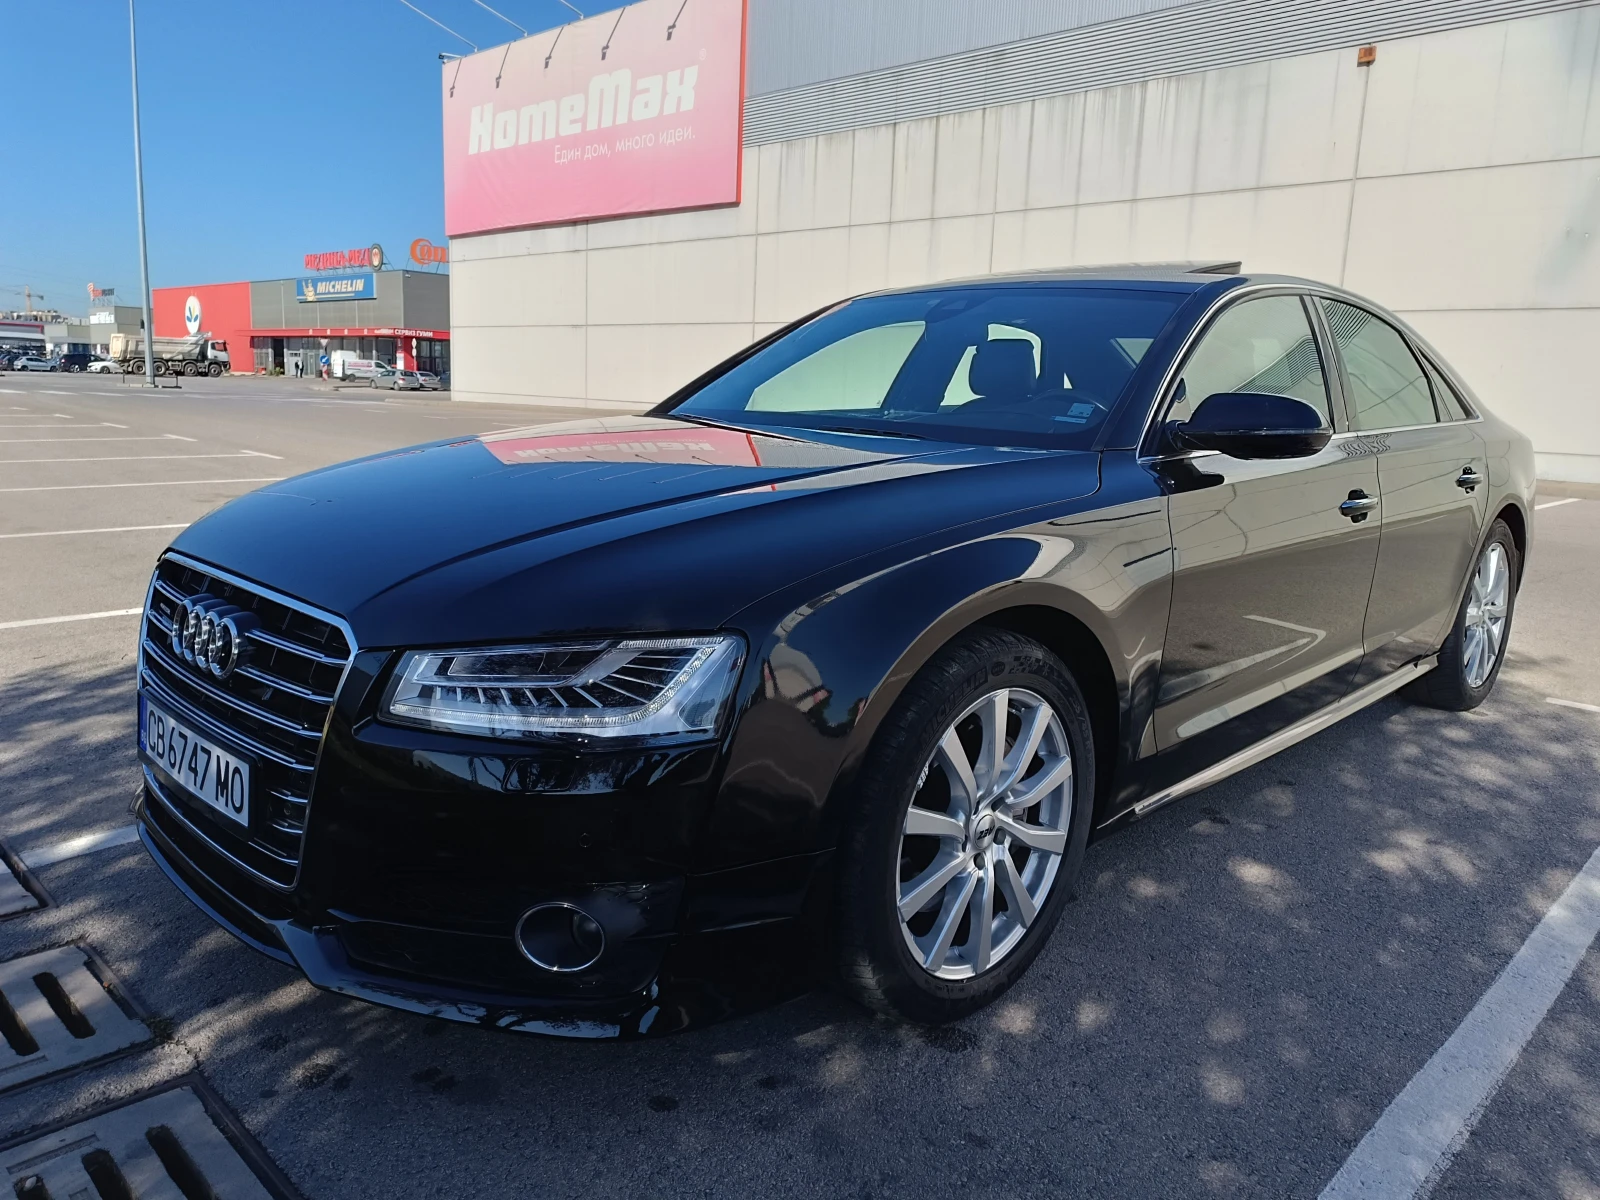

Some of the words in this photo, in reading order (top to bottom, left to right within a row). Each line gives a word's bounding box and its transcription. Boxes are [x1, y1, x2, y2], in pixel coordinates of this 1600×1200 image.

[468, 65, 699, 155] HomeMax
[554, 145, 581, 165] Един
[584, 143, 612, 160] дом,
[615, 132, 655, 152] много
[658, 126, 696, 145] идеи.
[410, 238, 449, 265] Con
[316, 279, 365, 294] MICHELIN
